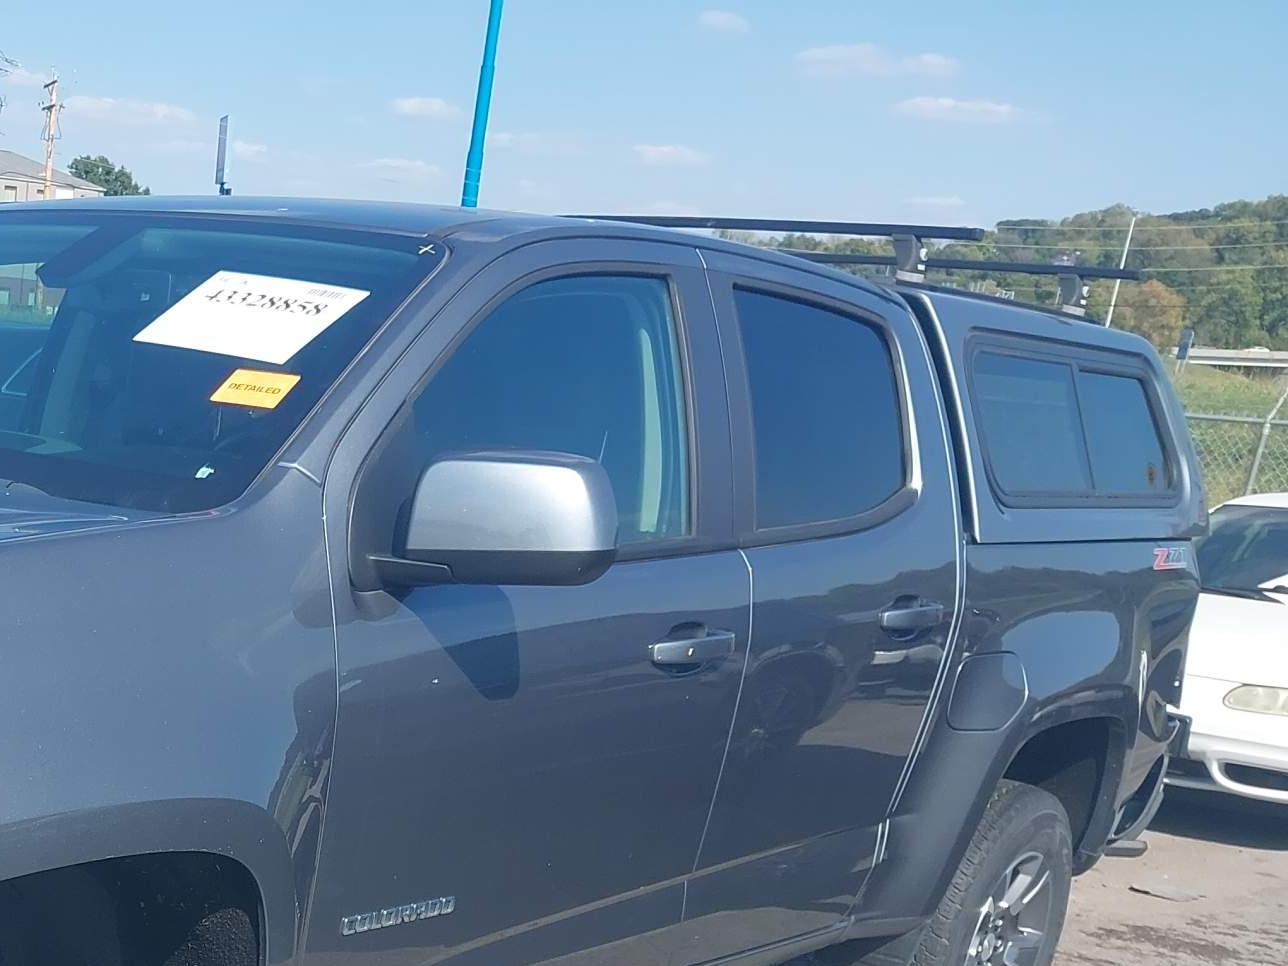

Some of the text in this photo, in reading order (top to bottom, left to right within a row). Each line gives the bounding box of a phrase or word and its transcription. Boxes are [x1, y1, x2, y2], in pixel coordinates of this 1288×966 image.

[205, 288, 329, 317] 43328858
[228, 382, 282, 396] DETAILED
[1152, 547, 1187, 570] Z71
[339, 896, 456, 936] COLORADO
